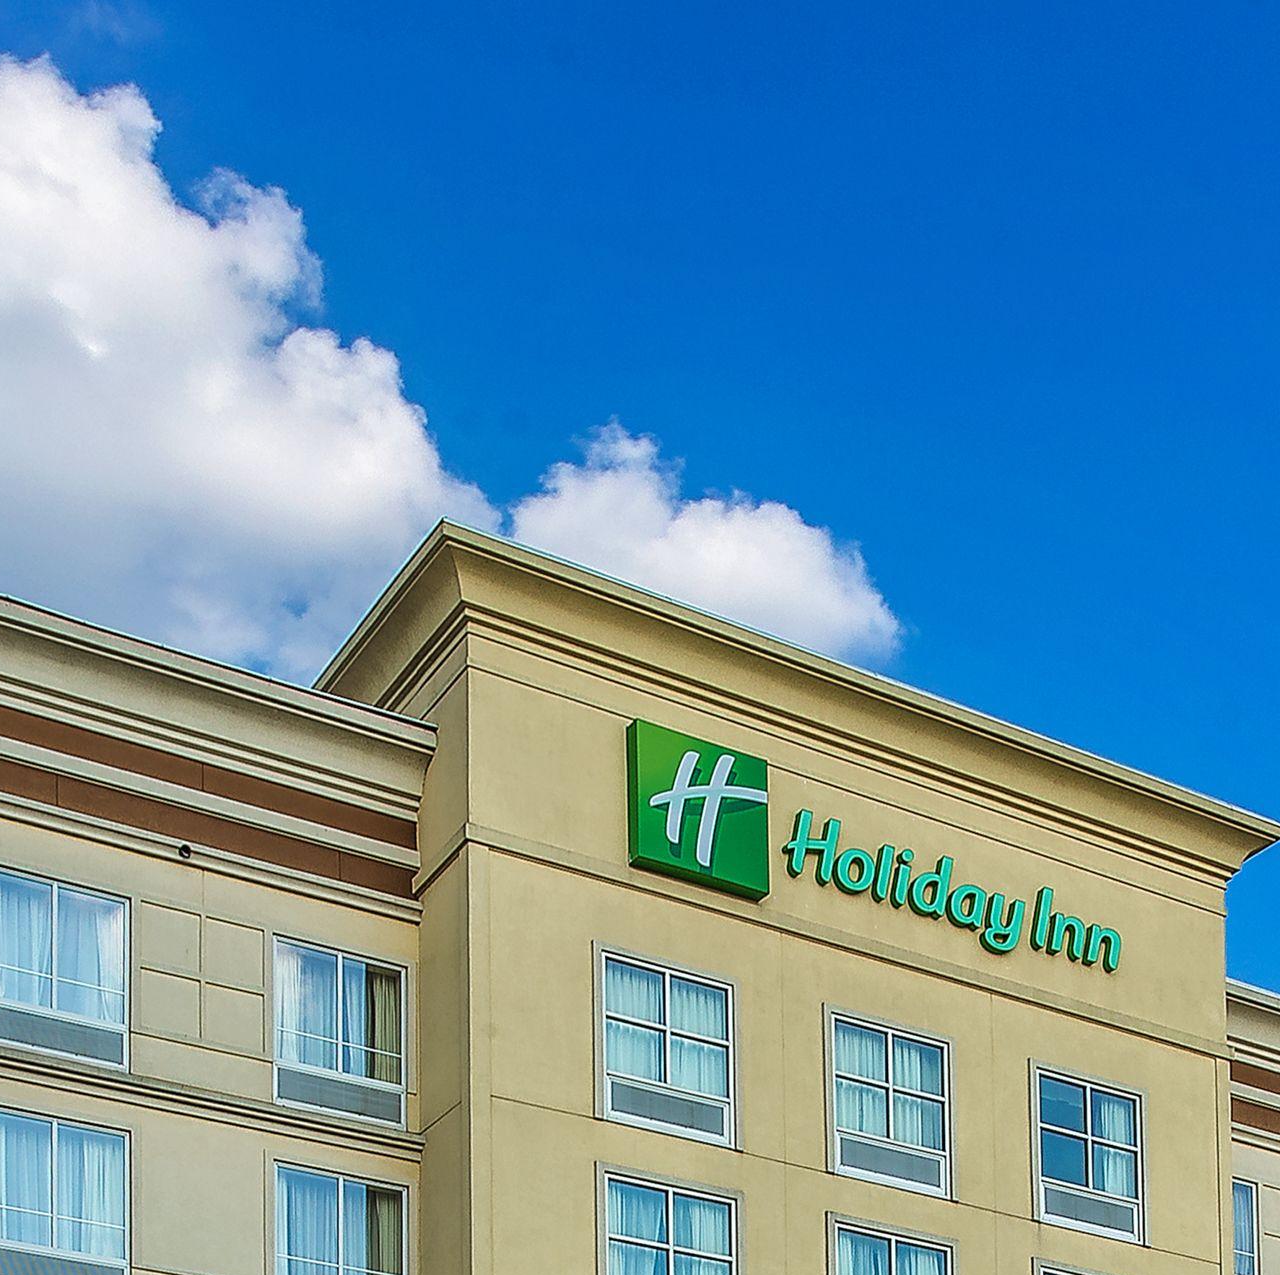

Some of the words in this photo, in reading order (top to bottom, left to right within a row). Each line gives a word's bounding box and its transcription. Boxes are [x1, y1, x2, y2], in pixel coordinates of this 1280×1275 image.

[650, 751, 767, 867] H
[784, 809, 1025, 954] Holiday
[1031, 886, 1122, 973] Inn
